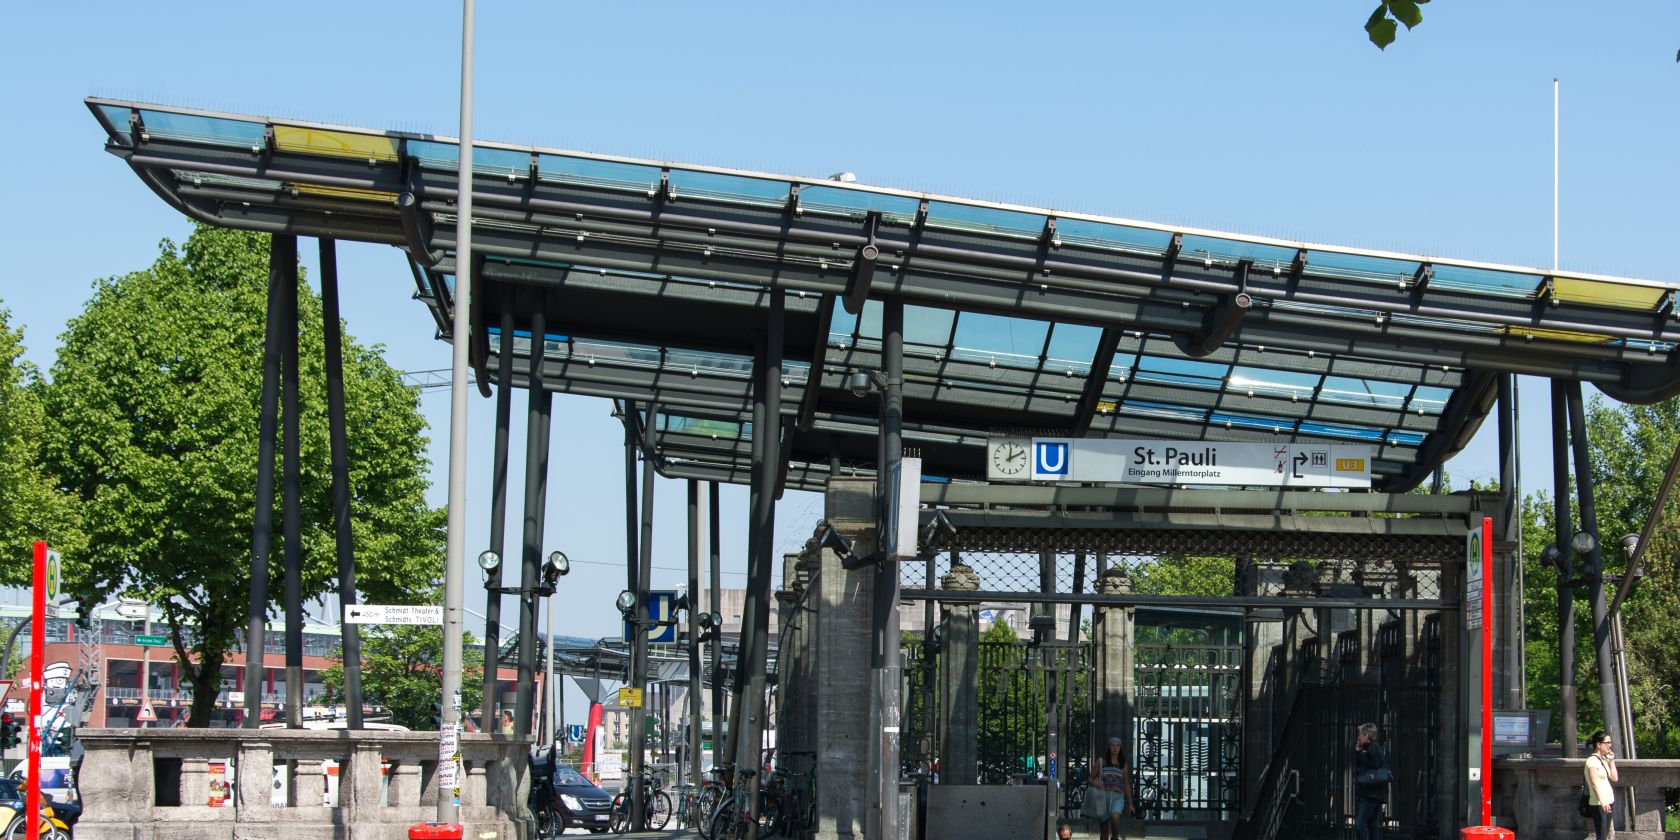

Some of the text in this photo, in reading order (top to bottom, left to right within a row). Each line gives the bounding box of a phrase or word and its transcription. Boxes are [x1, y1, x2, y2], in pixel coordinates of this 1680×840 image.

[1040, 444, 1064, 472] U
[1134, 446, 1217, 466] St. Pauli
[1128, 468, 1221, 479] Eingang Millerntorplatz
[384, 606, 409, 614] Schmidt
[411, 607, 433, 615] Theater
[415, 616, 440, 624] TIVOLI
